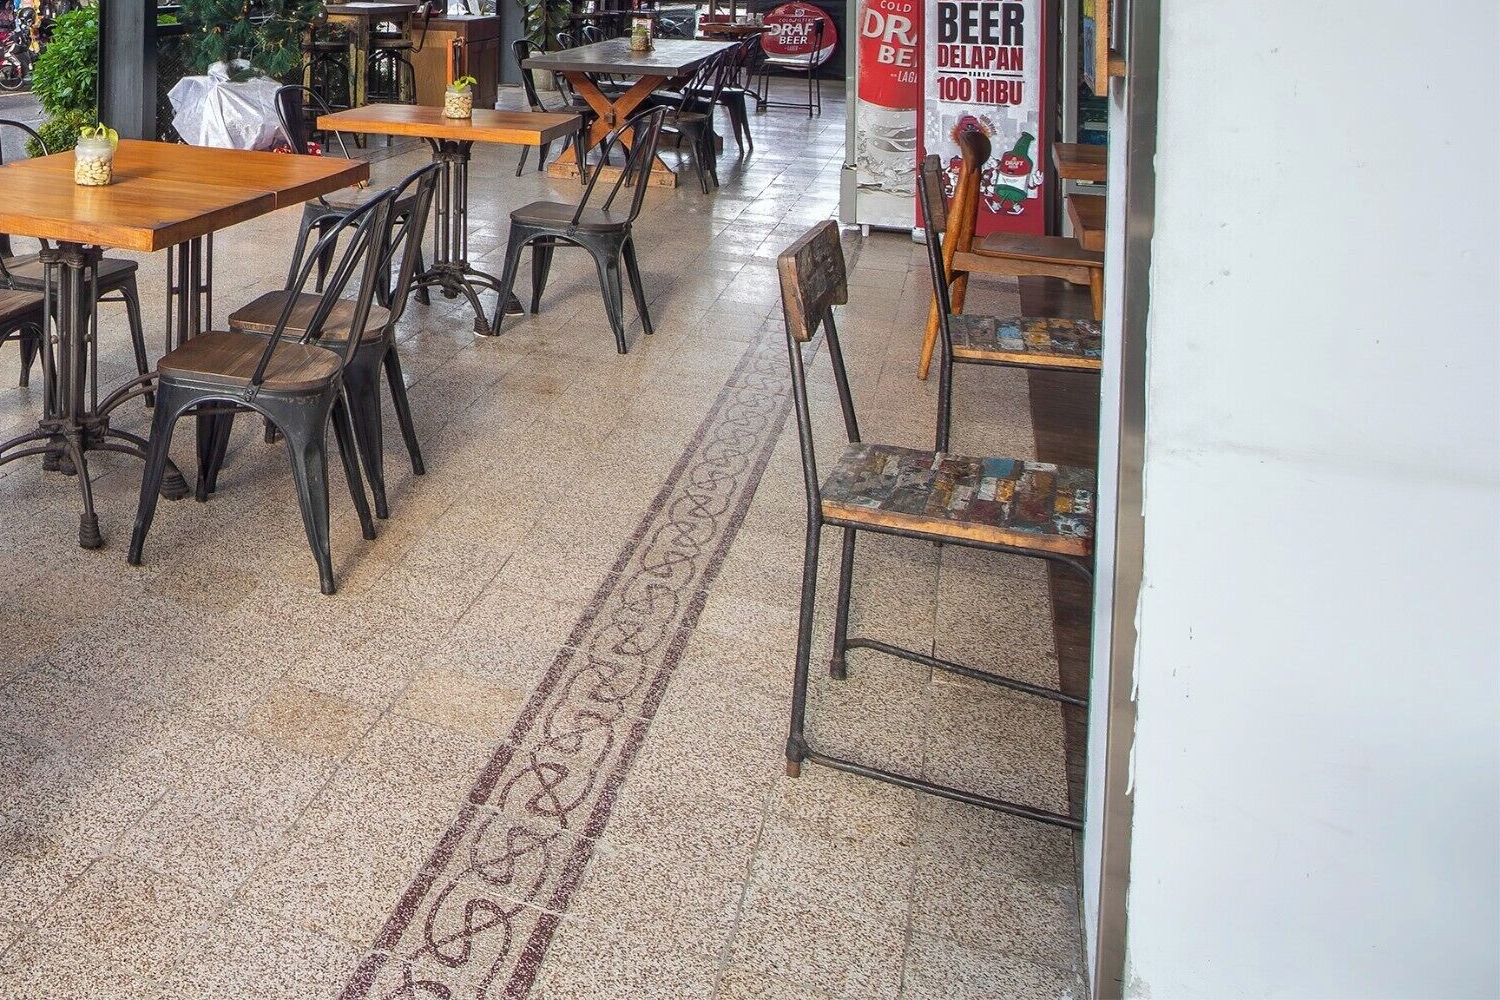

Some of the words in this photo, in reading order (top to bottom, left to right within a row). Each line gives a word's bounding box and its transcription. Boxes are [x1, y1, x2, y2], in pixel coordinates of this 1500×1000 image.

[880, 0, 912, 13] COLD
[768, 23, 814, 36] DRAF
[937, 3, 1025, 46] BEER
[779, 36, 808, 44] BEER
[877, 44, 917, 67] BE
[937, 45, 1024, 71] DELAPAN
[937, 77, 972, 102] 100
